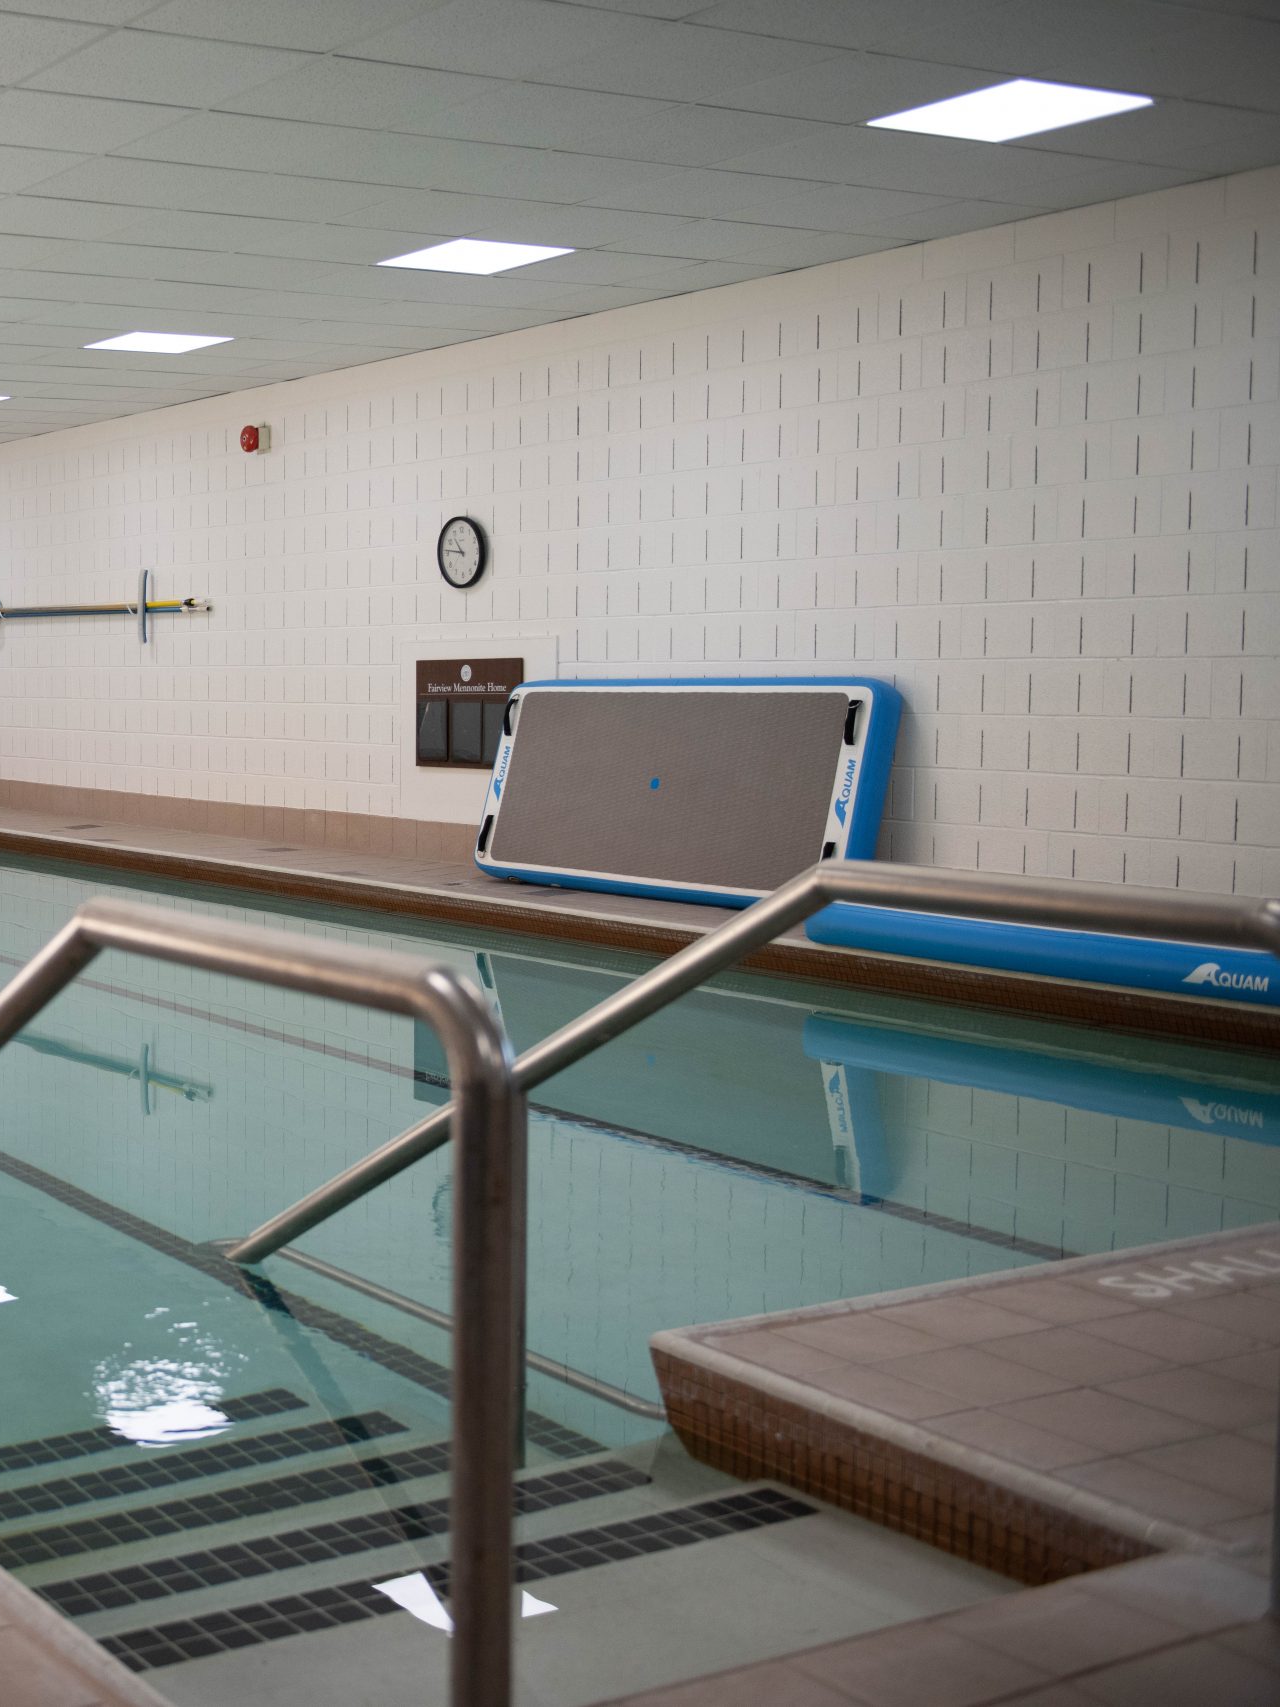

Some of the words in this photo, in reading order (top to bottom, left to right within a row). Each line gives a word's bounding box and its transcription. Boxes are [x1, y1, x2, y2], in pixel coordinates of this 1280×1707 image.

[427, 683, 452, 693] Fairview
[453, 683, 485, 692] Mennonite
[487, 682, 507, 692] Home
[493, 746, 511, 801] AQUAM
[834, 759, 857, 829] AQUAM
[1181, 962, 1270, 992] AQUAM
